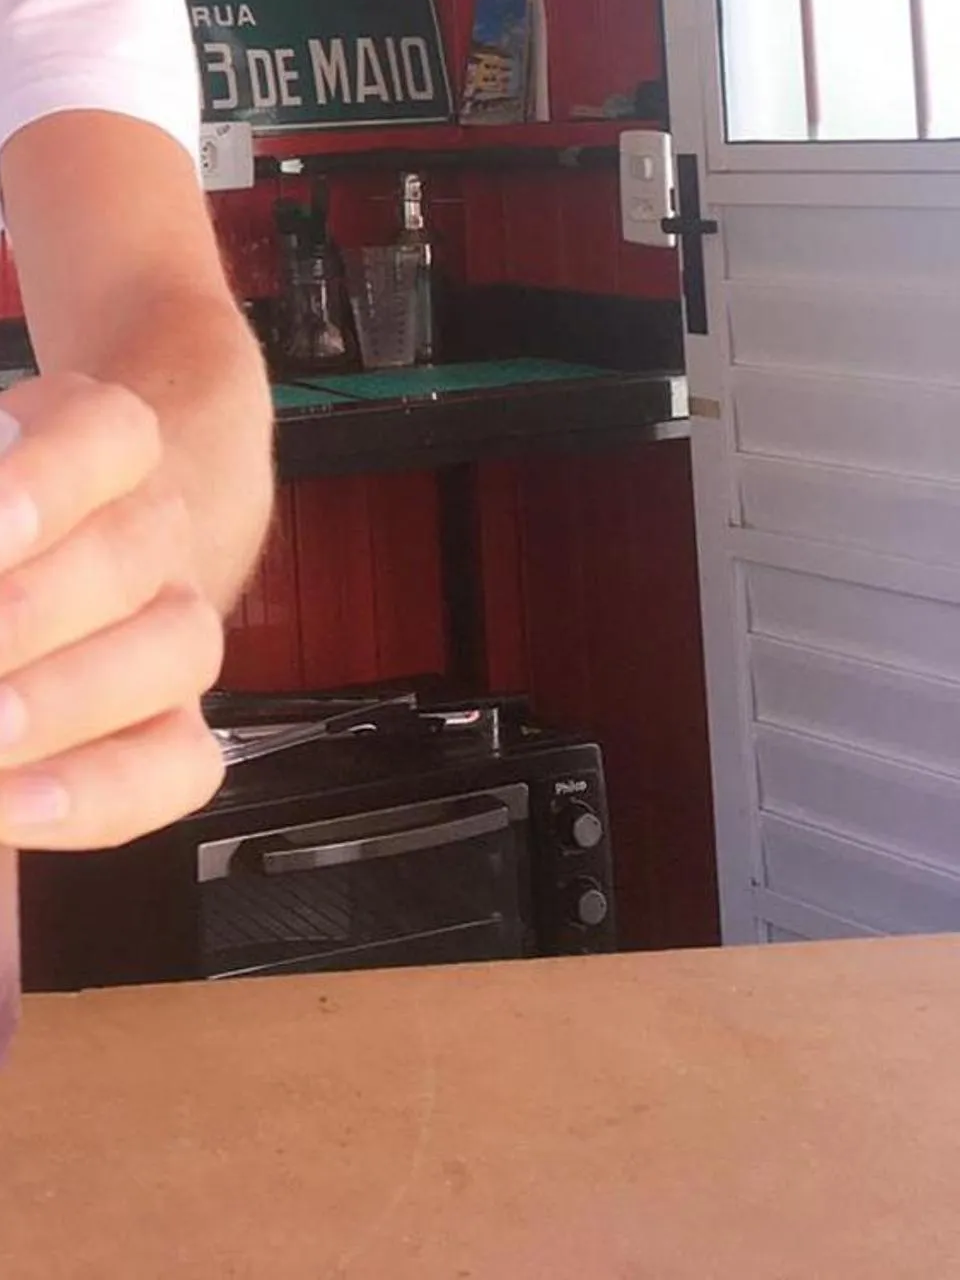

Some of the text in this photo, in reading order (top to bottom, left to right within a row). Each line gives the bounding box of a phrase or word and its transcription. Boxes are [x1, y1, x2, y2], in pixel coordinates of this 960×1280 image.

[191, 4, 257, 28] RUA
[247, 48, 303, 109] DE
[309, 36, 435, 106] MAIO
